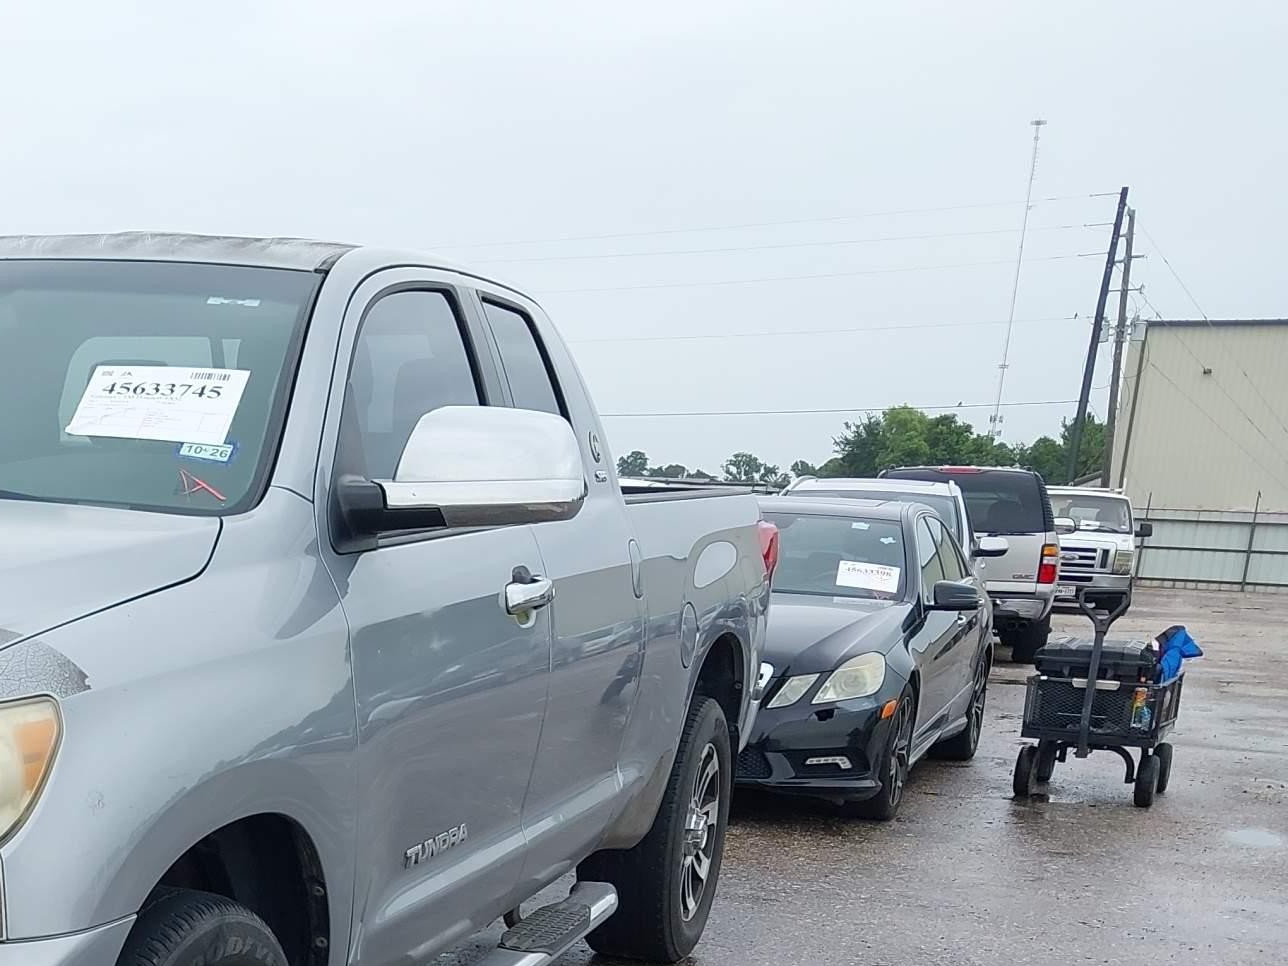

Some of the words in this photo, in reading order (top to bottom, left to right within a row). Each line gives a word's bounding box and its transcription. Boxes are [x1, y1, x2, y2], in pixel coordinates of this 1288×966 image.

[102, 381, 224, 400] 45633745
[186, 445, 203, 455] 10
[209, 448, 229, 458] 26
[405, 823, 469, 868] TUNDRA
